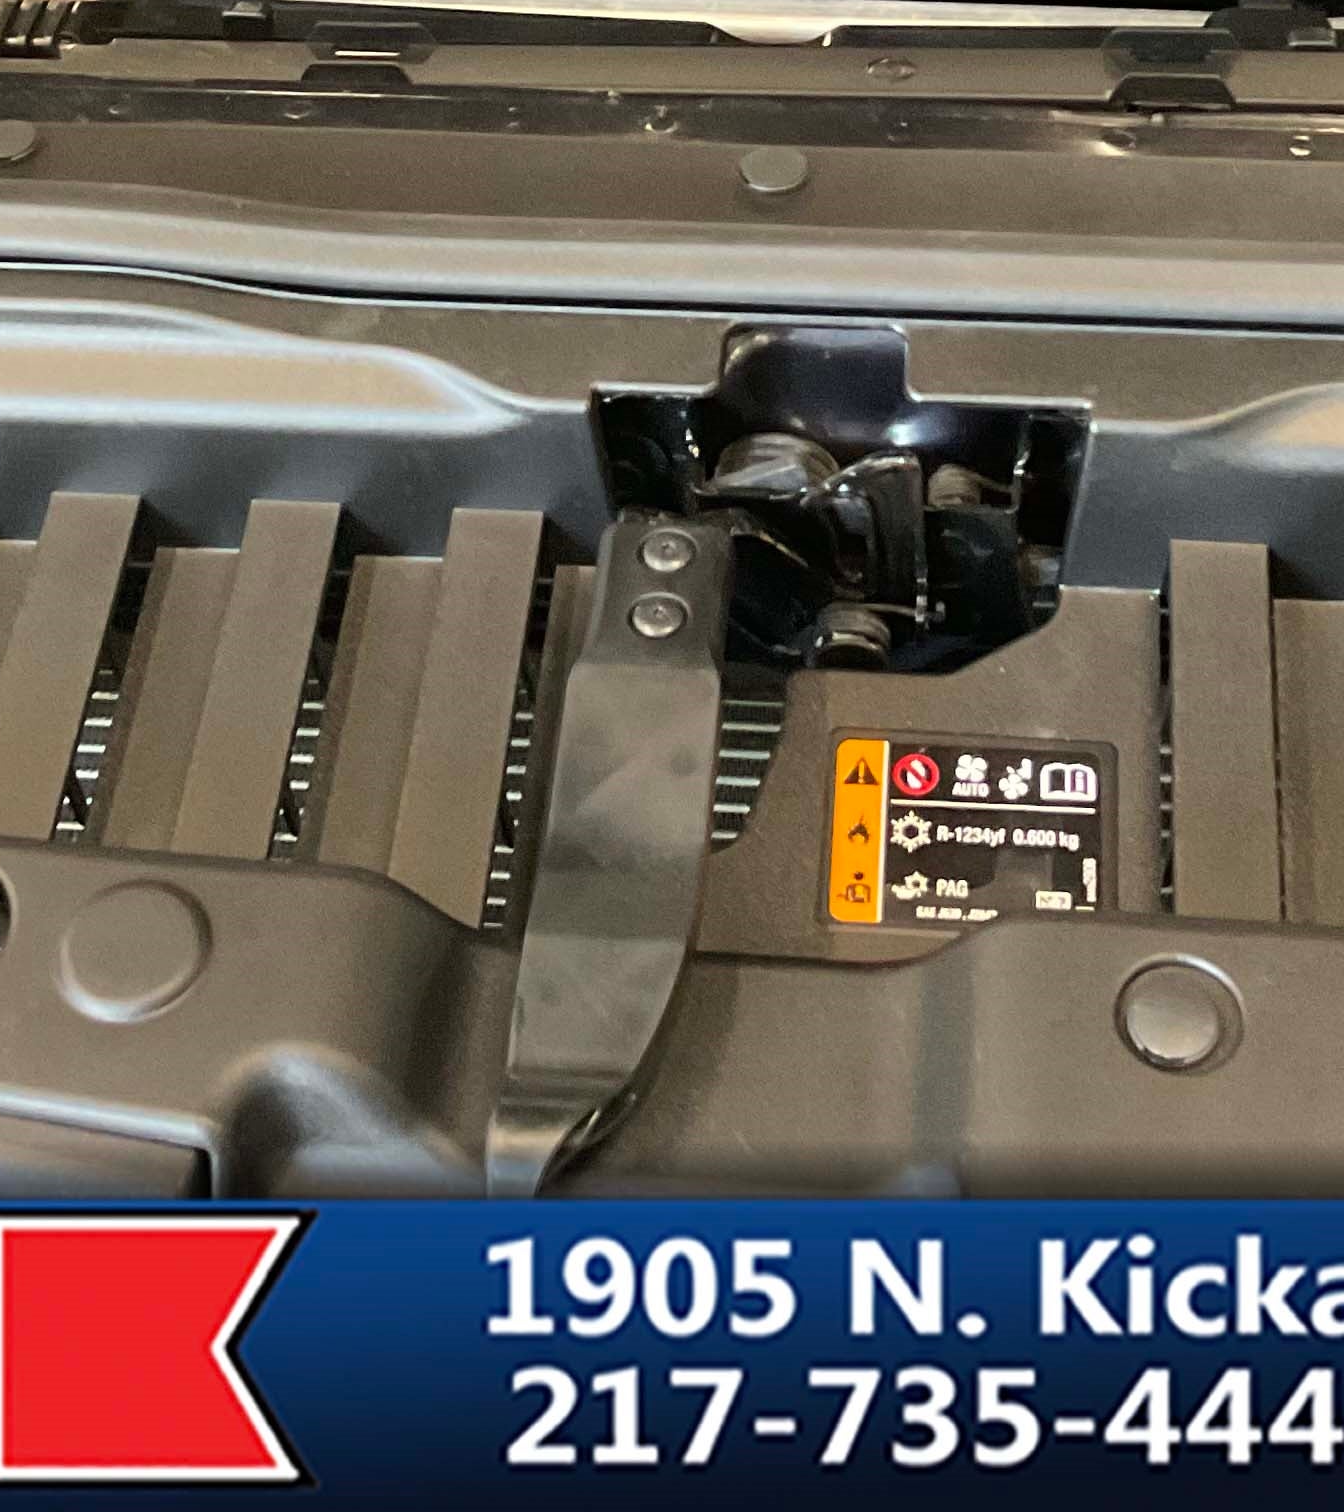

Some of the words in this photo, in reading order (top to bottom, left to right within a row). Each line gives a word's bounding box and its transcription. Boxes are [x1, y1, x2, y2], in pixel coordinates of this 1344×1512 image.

[951, 781, 989, 798] AUTO
[936, 824, 1006, 848] R-1234yf
[1012, 827, 1056, 846] 0.600
[1058, 831, 1080, 851] kg
[935, 878, 968, 898] PAG
